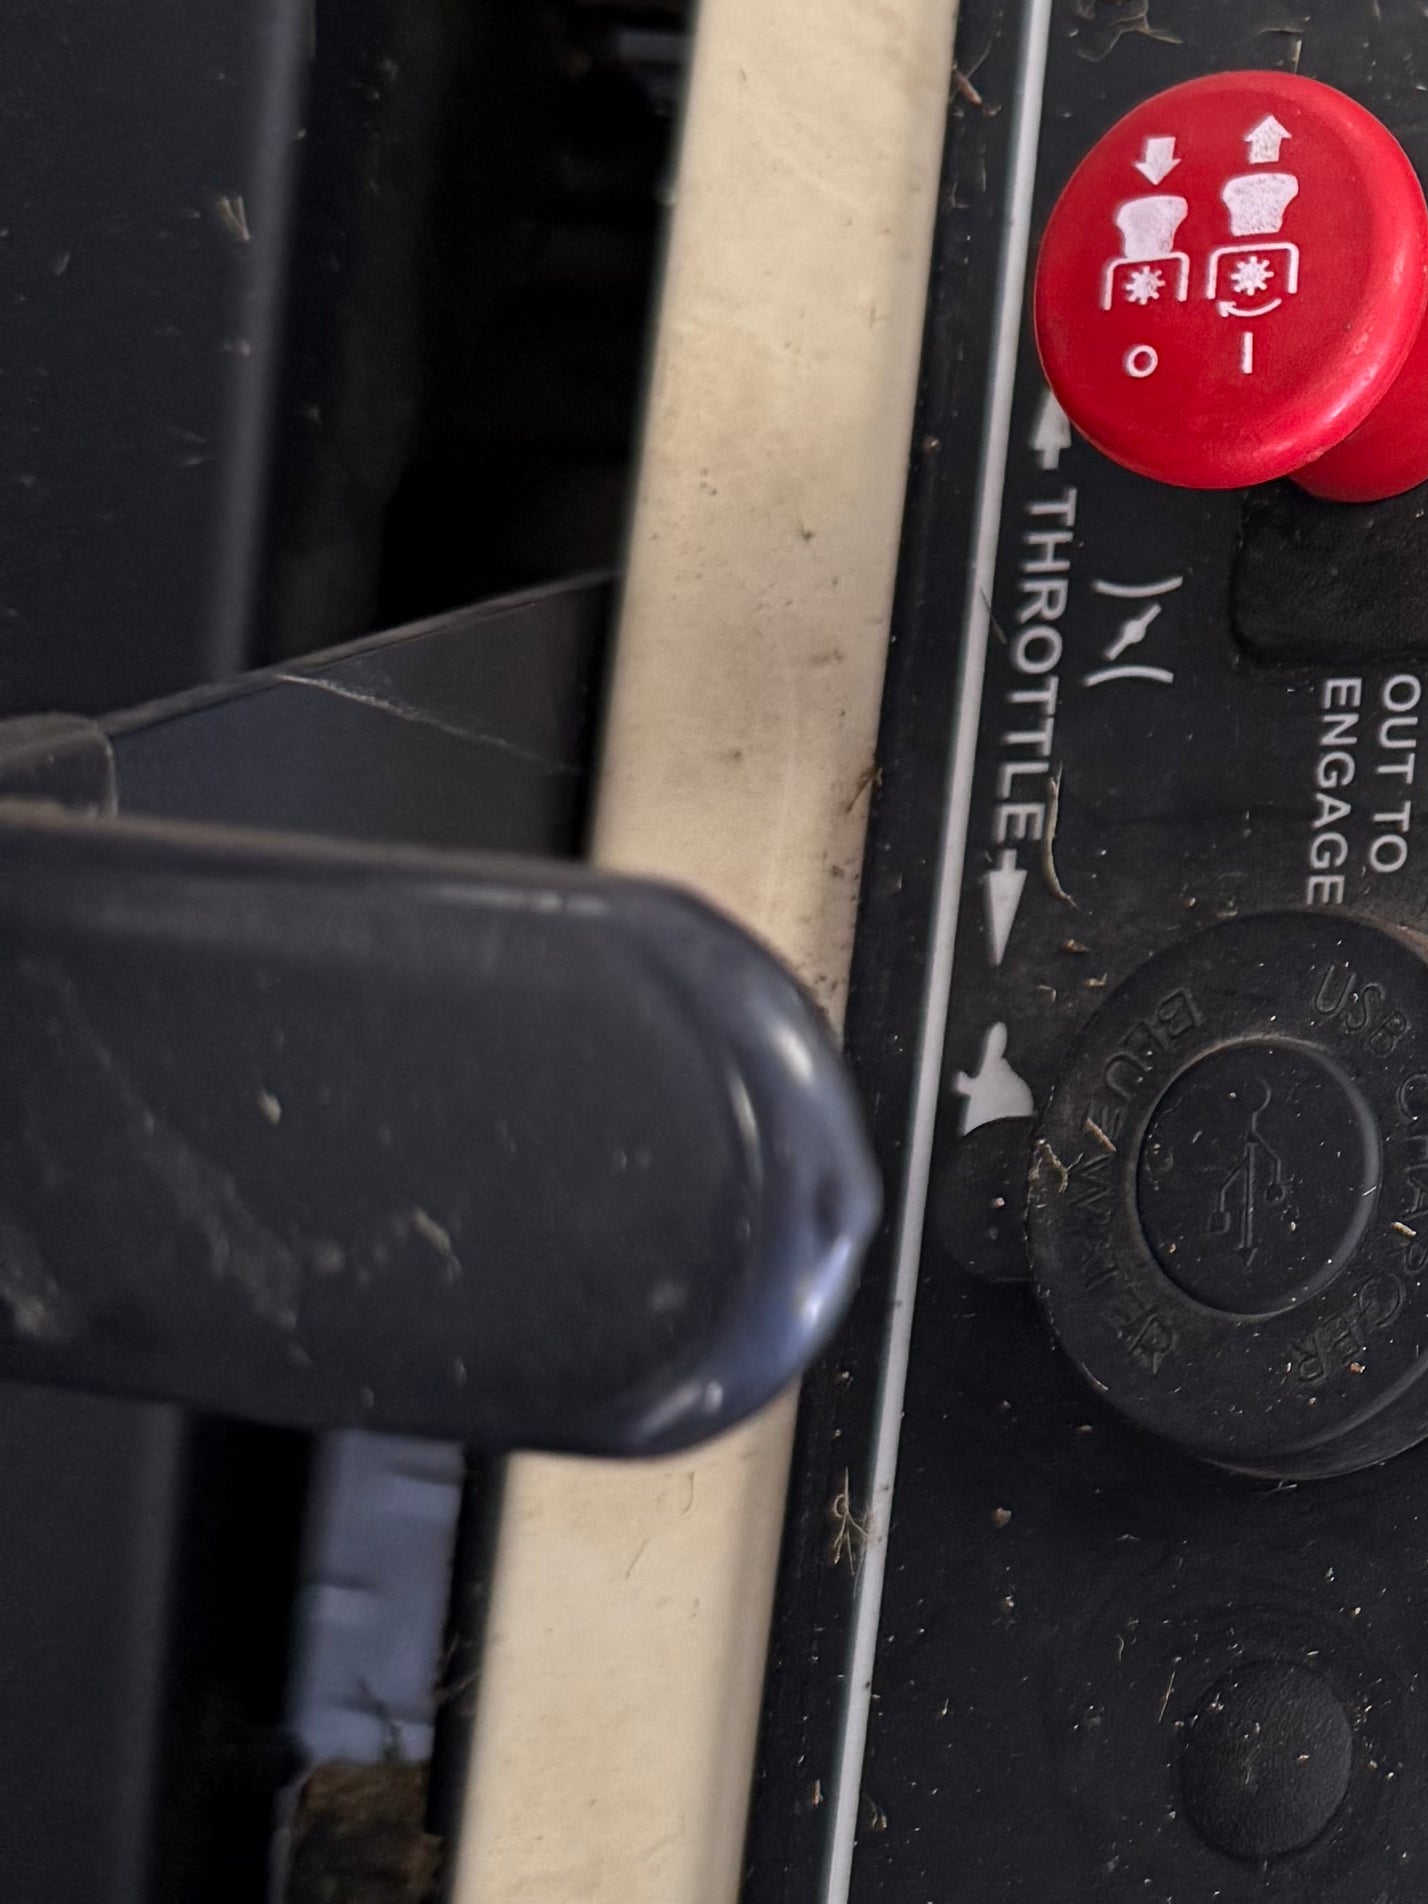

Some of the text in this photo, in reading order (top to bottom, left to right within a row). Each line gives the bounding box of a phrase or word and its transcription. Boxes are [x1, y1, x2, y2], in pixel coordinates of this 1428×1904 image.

[994, 489, 1078, 842] THROTTLE
[1306, 677, 1364, 906] ENGAGE
[1368, 675, 1422, 874] OUT TO
[1313, 965, 1411, 1059] USB
